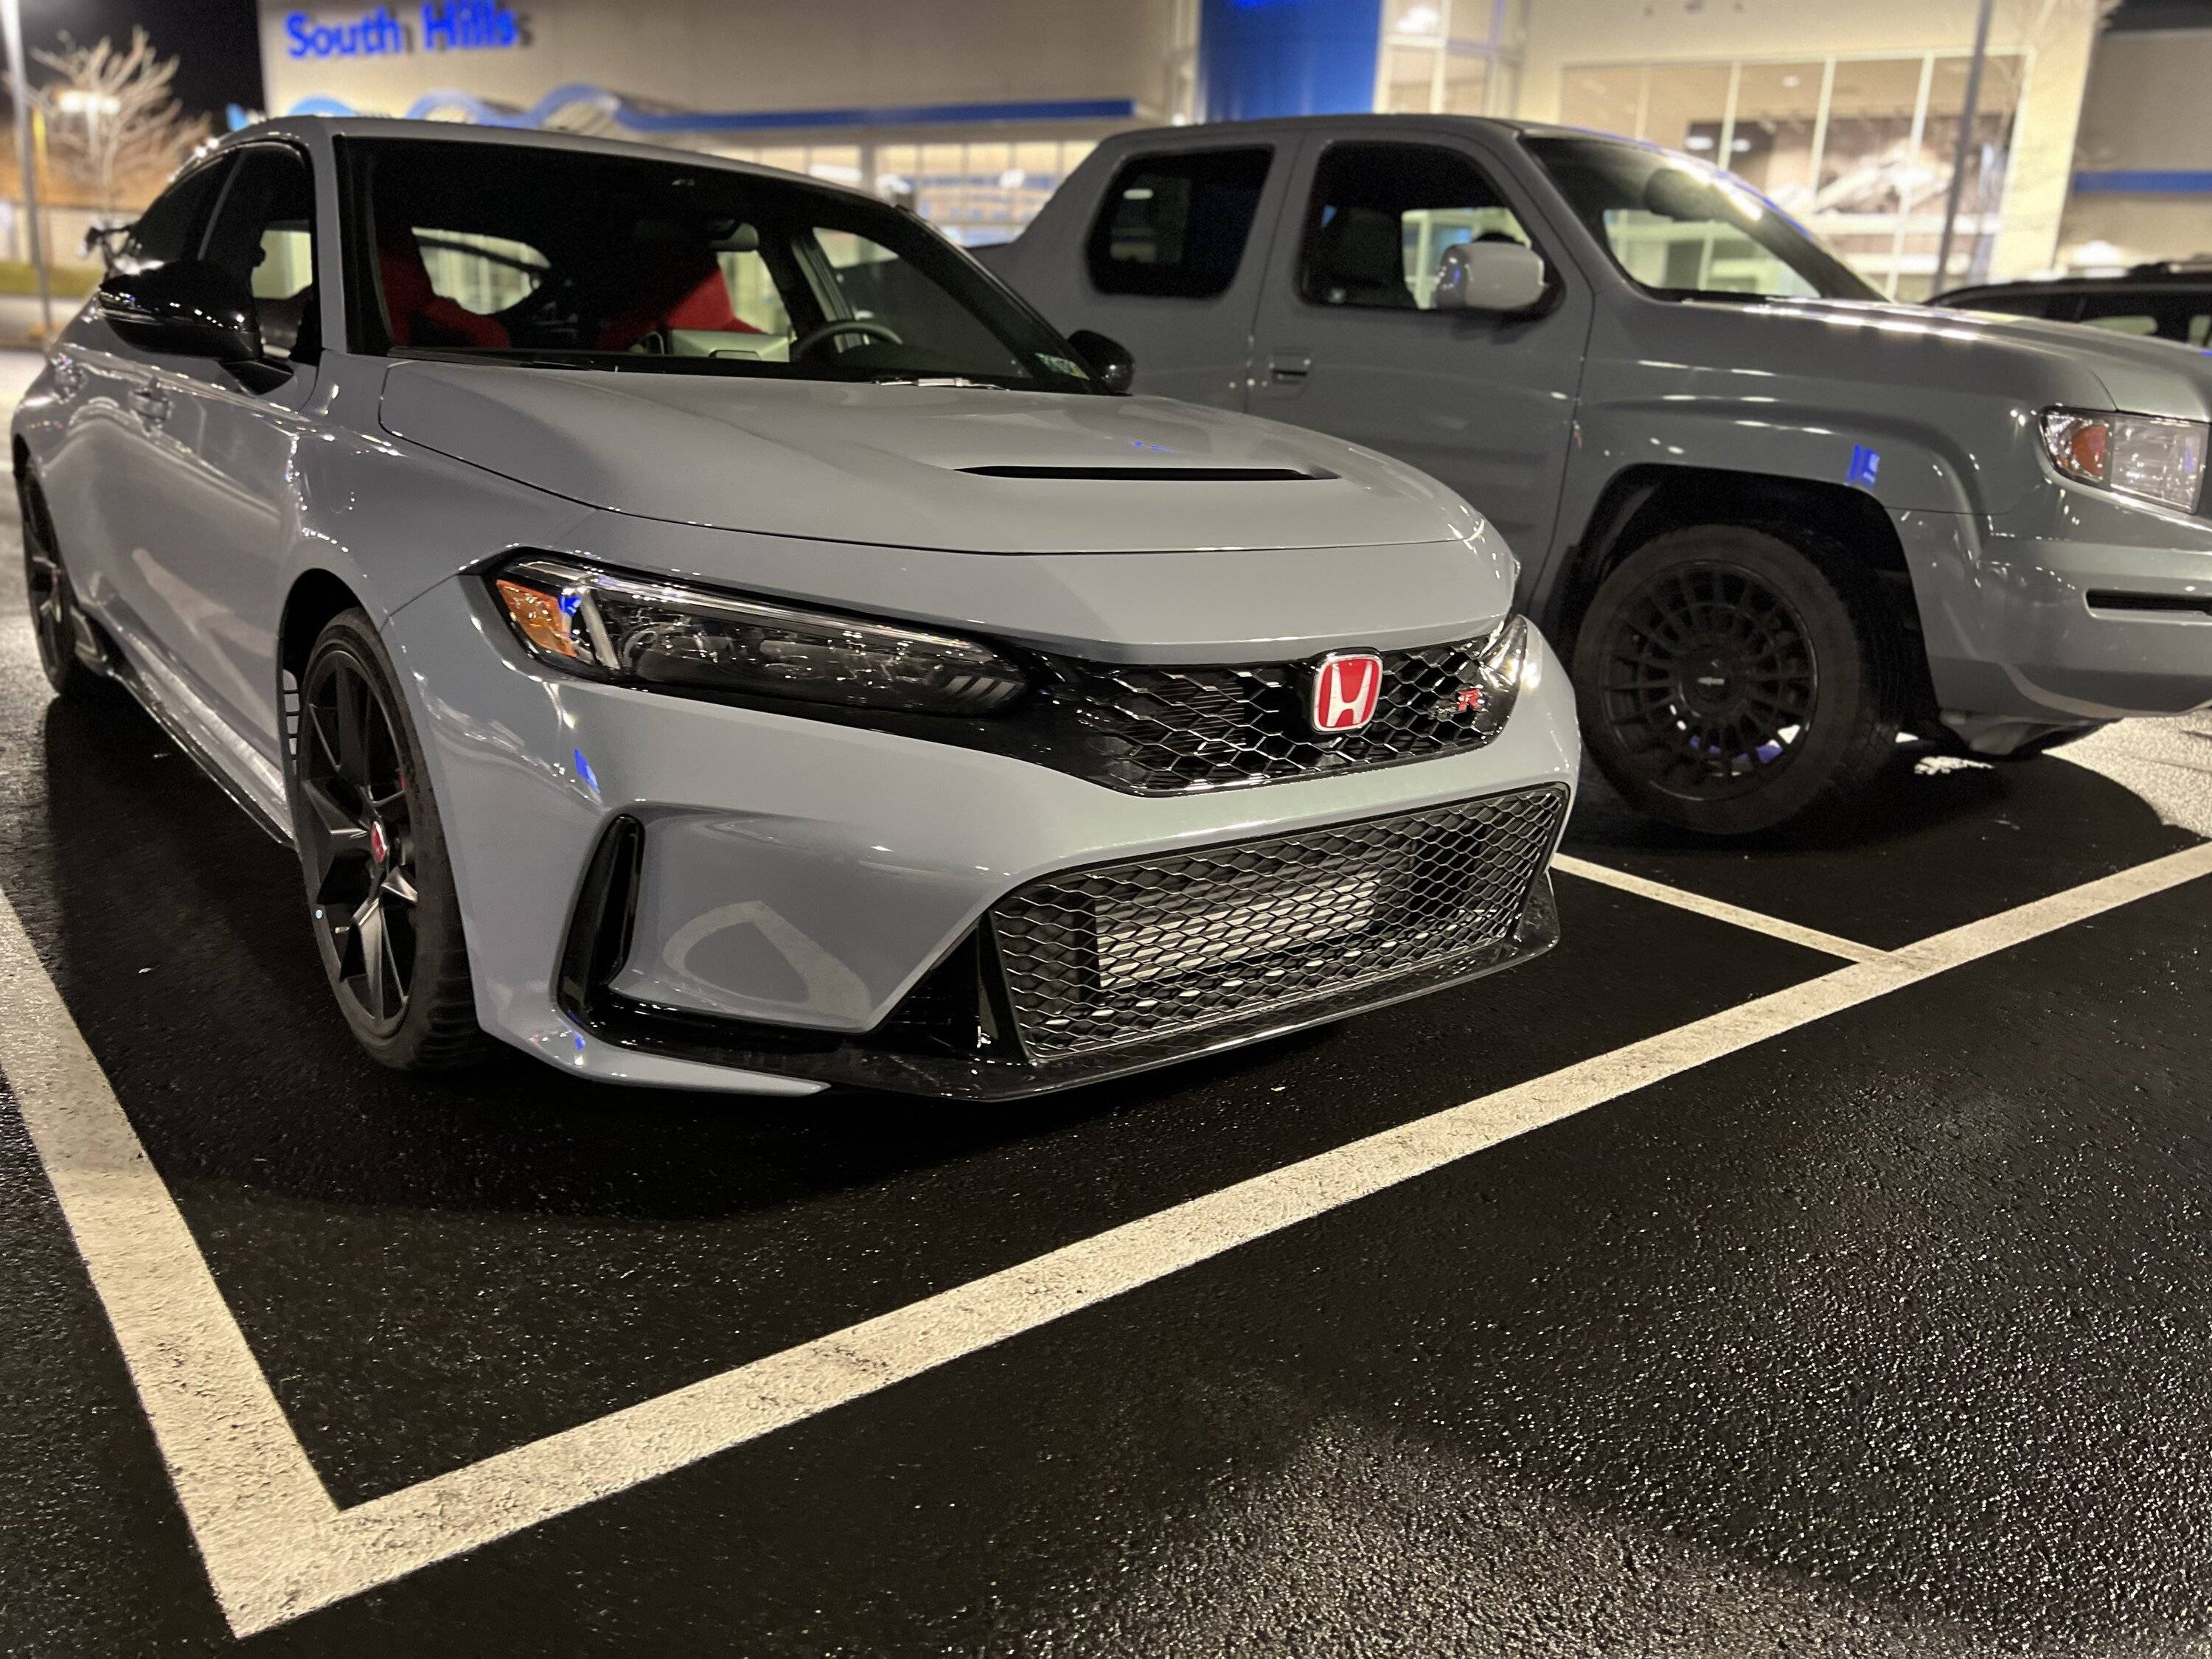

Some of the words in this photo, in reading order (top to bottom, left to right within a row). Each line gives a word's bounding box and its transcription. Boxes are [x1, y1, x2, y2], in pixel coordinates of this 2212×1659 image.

[286, 7, 402, 58] South
[421, 0, 518, 49] Hills
[1325, 660, 1376, 728] H
